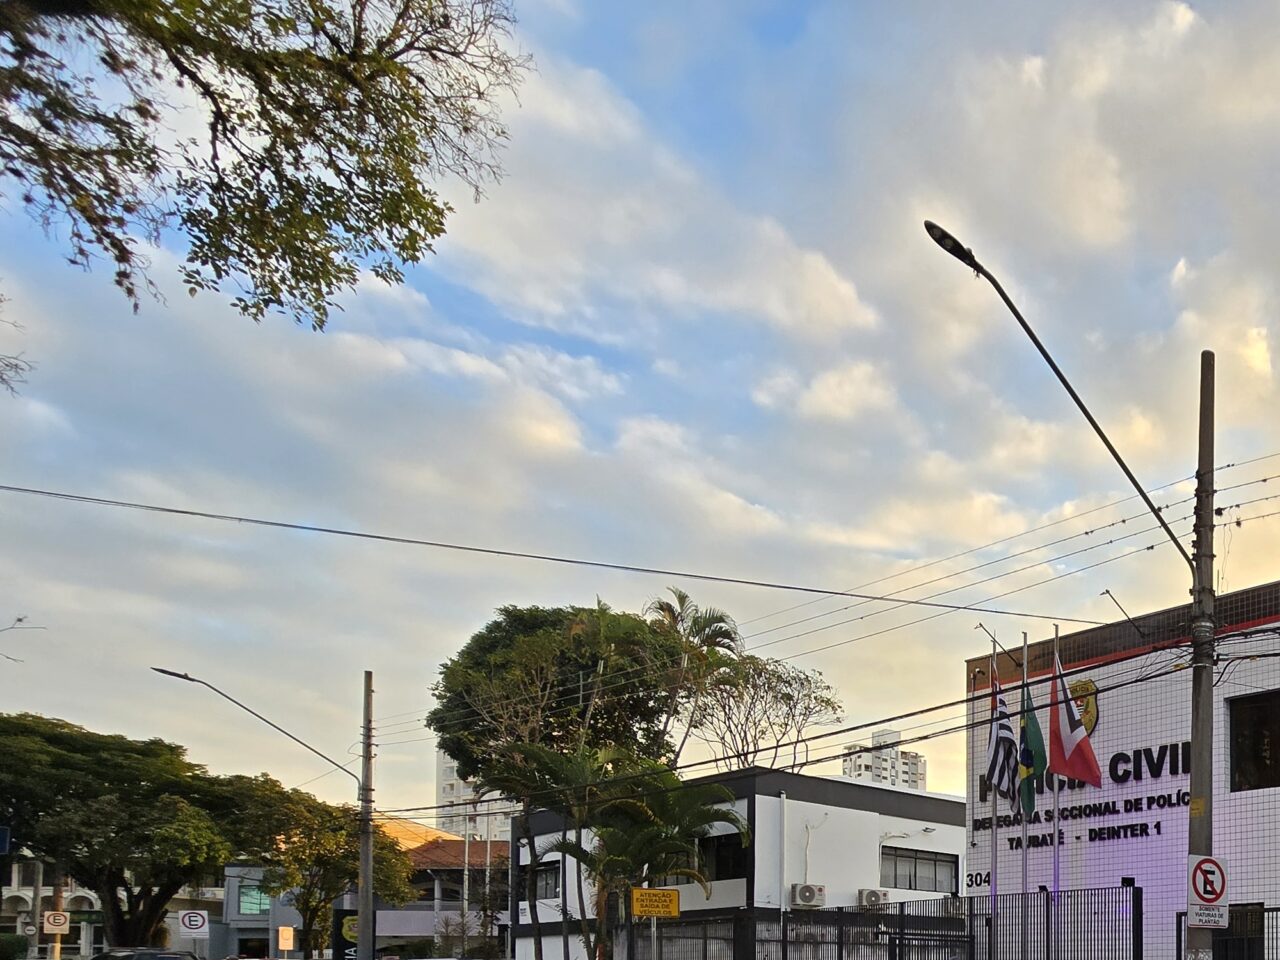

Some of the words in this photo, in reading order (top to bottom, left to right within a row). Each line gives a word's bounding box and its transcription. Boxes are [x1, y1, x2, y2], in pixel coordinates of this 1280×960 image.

[1044, 801, 1120, 822] SCCIONAL
[1124, 798, 1143, 813] DE
[1147, 789, 1191, 810] POLÍC
[1089, 823, 1150, 842] DEINTER
[1154, 821, 1161, 835] 1
[966, 872, 991, 888] 304
